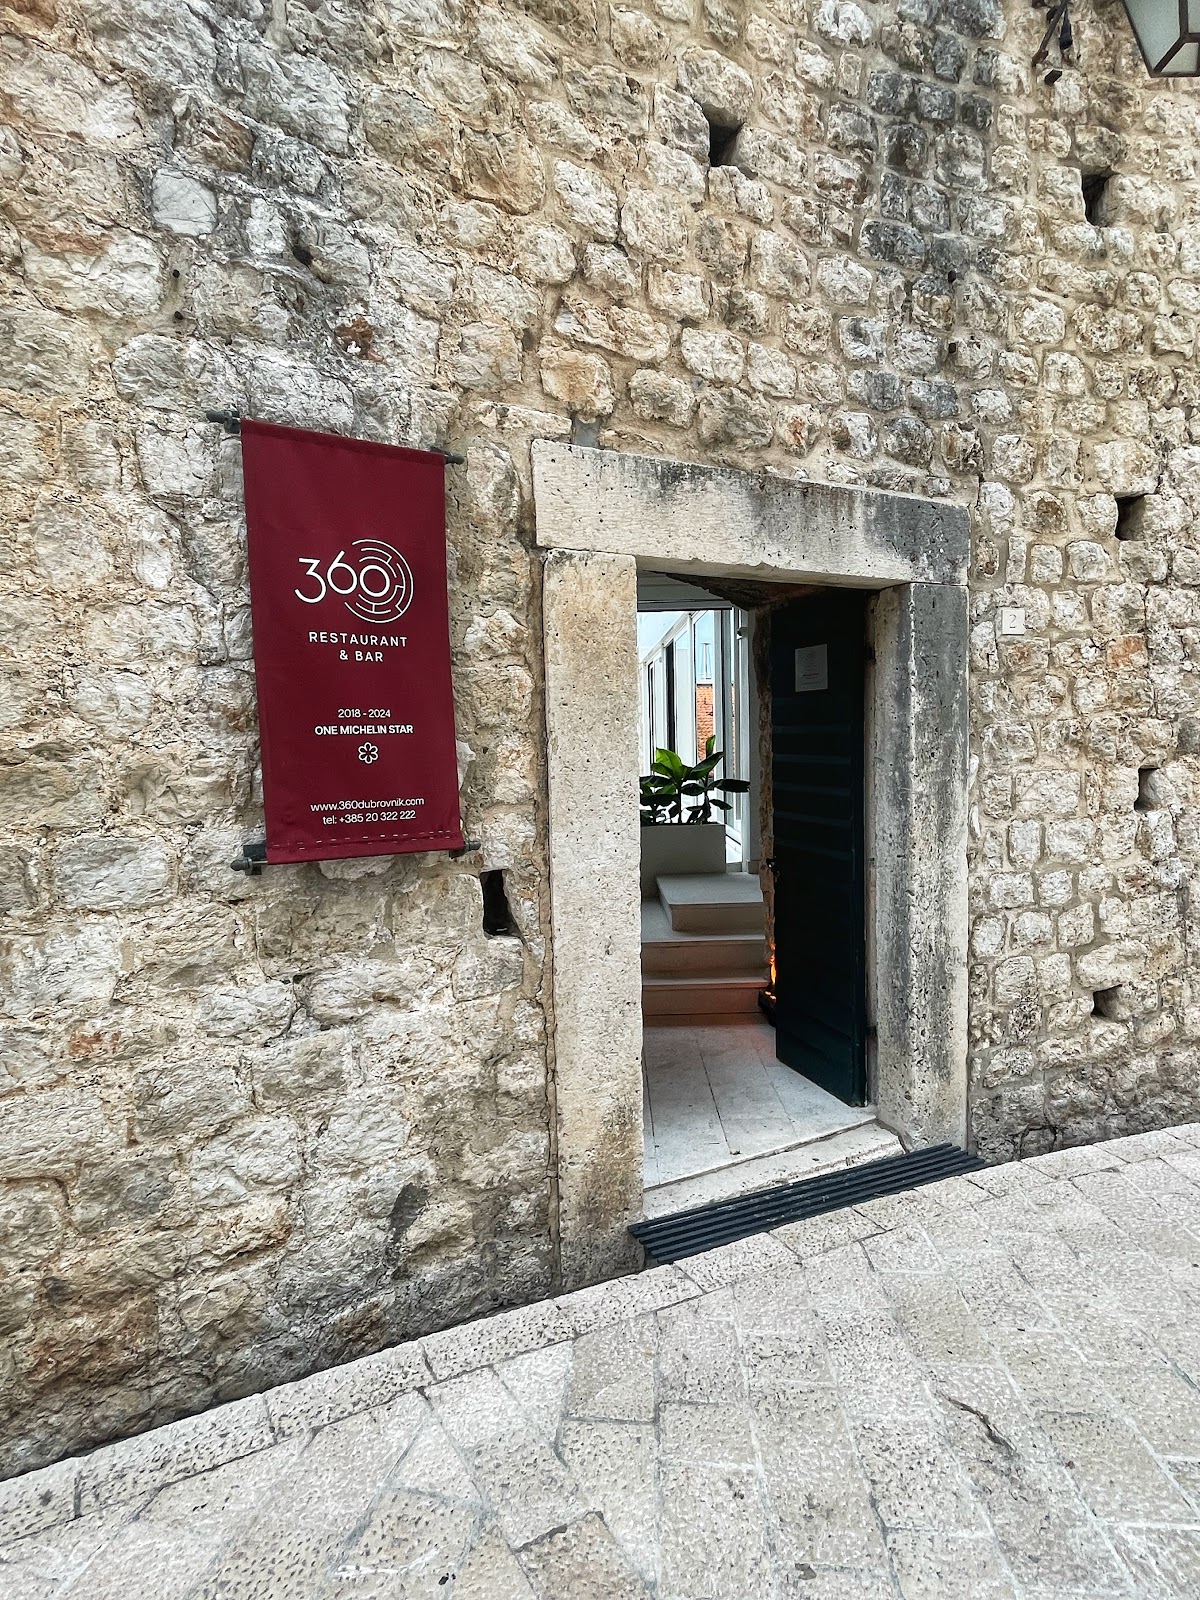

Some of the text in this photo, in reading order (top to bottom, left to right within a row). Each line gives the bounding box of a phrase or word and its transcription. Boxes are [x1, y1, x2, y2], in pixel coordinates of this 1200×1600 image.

[294, 550, 391, 604] 360
[1009, 613, 1017, 629] 2
[308, 631, 408, 648] RESTAURANT
[339, 649, 384, 663] & BAR
[337, 708, 362, 719] 2018
[368, 708, 391, 719] 2024
[314, 724, 414, 736] ONE MICHELIN STAR
[310, 797, 425, 812] www.360dubrovnik.com
[322, 809, 417, 825] tel: +385 20 322 222
